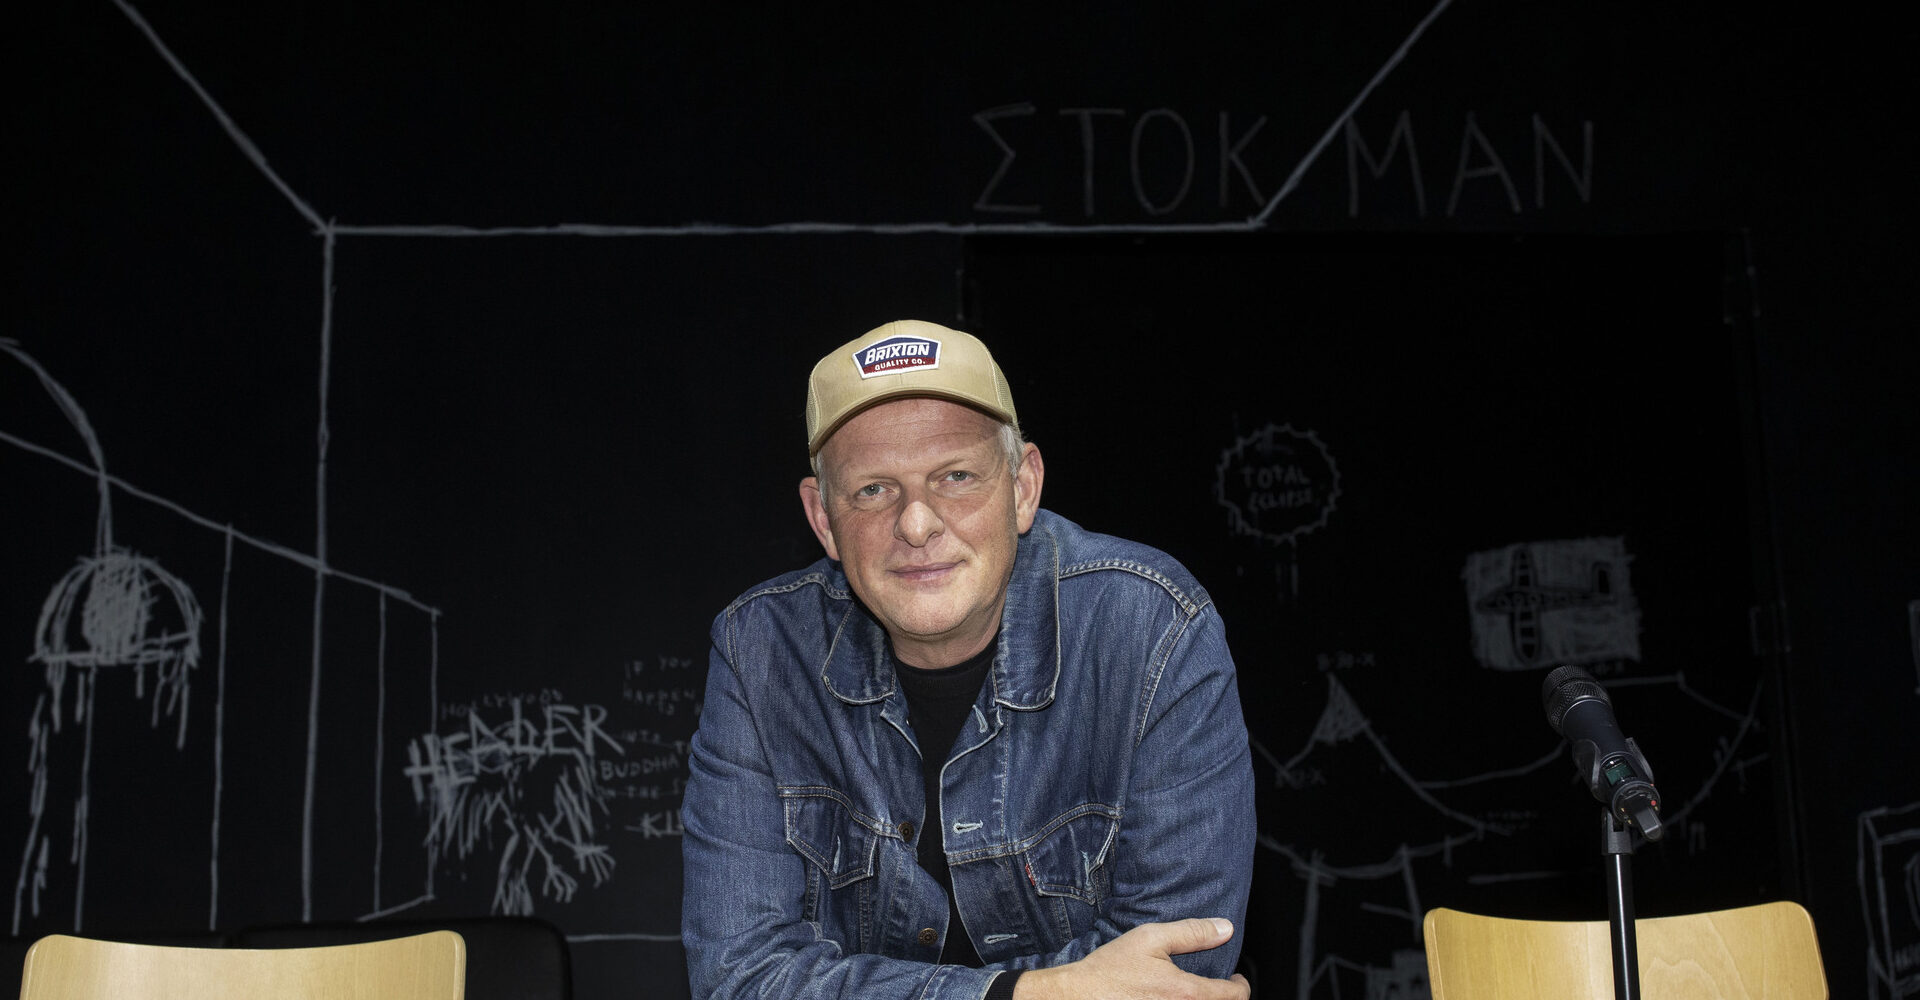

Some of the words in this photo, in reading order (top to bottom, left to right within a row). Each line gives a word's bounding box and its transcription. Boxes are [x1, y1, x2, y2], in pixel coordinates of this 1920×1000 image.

[864, 342, 930, 366] BRIXTON
[874, 358, 909, 371] QUALITY
[911, 357, 926, 365] CO.
[1239, 464, 1312, 489] TOTAL
[658, 655, 693, 673] YOU
[600, 753, 680, 782] BUDDHA
